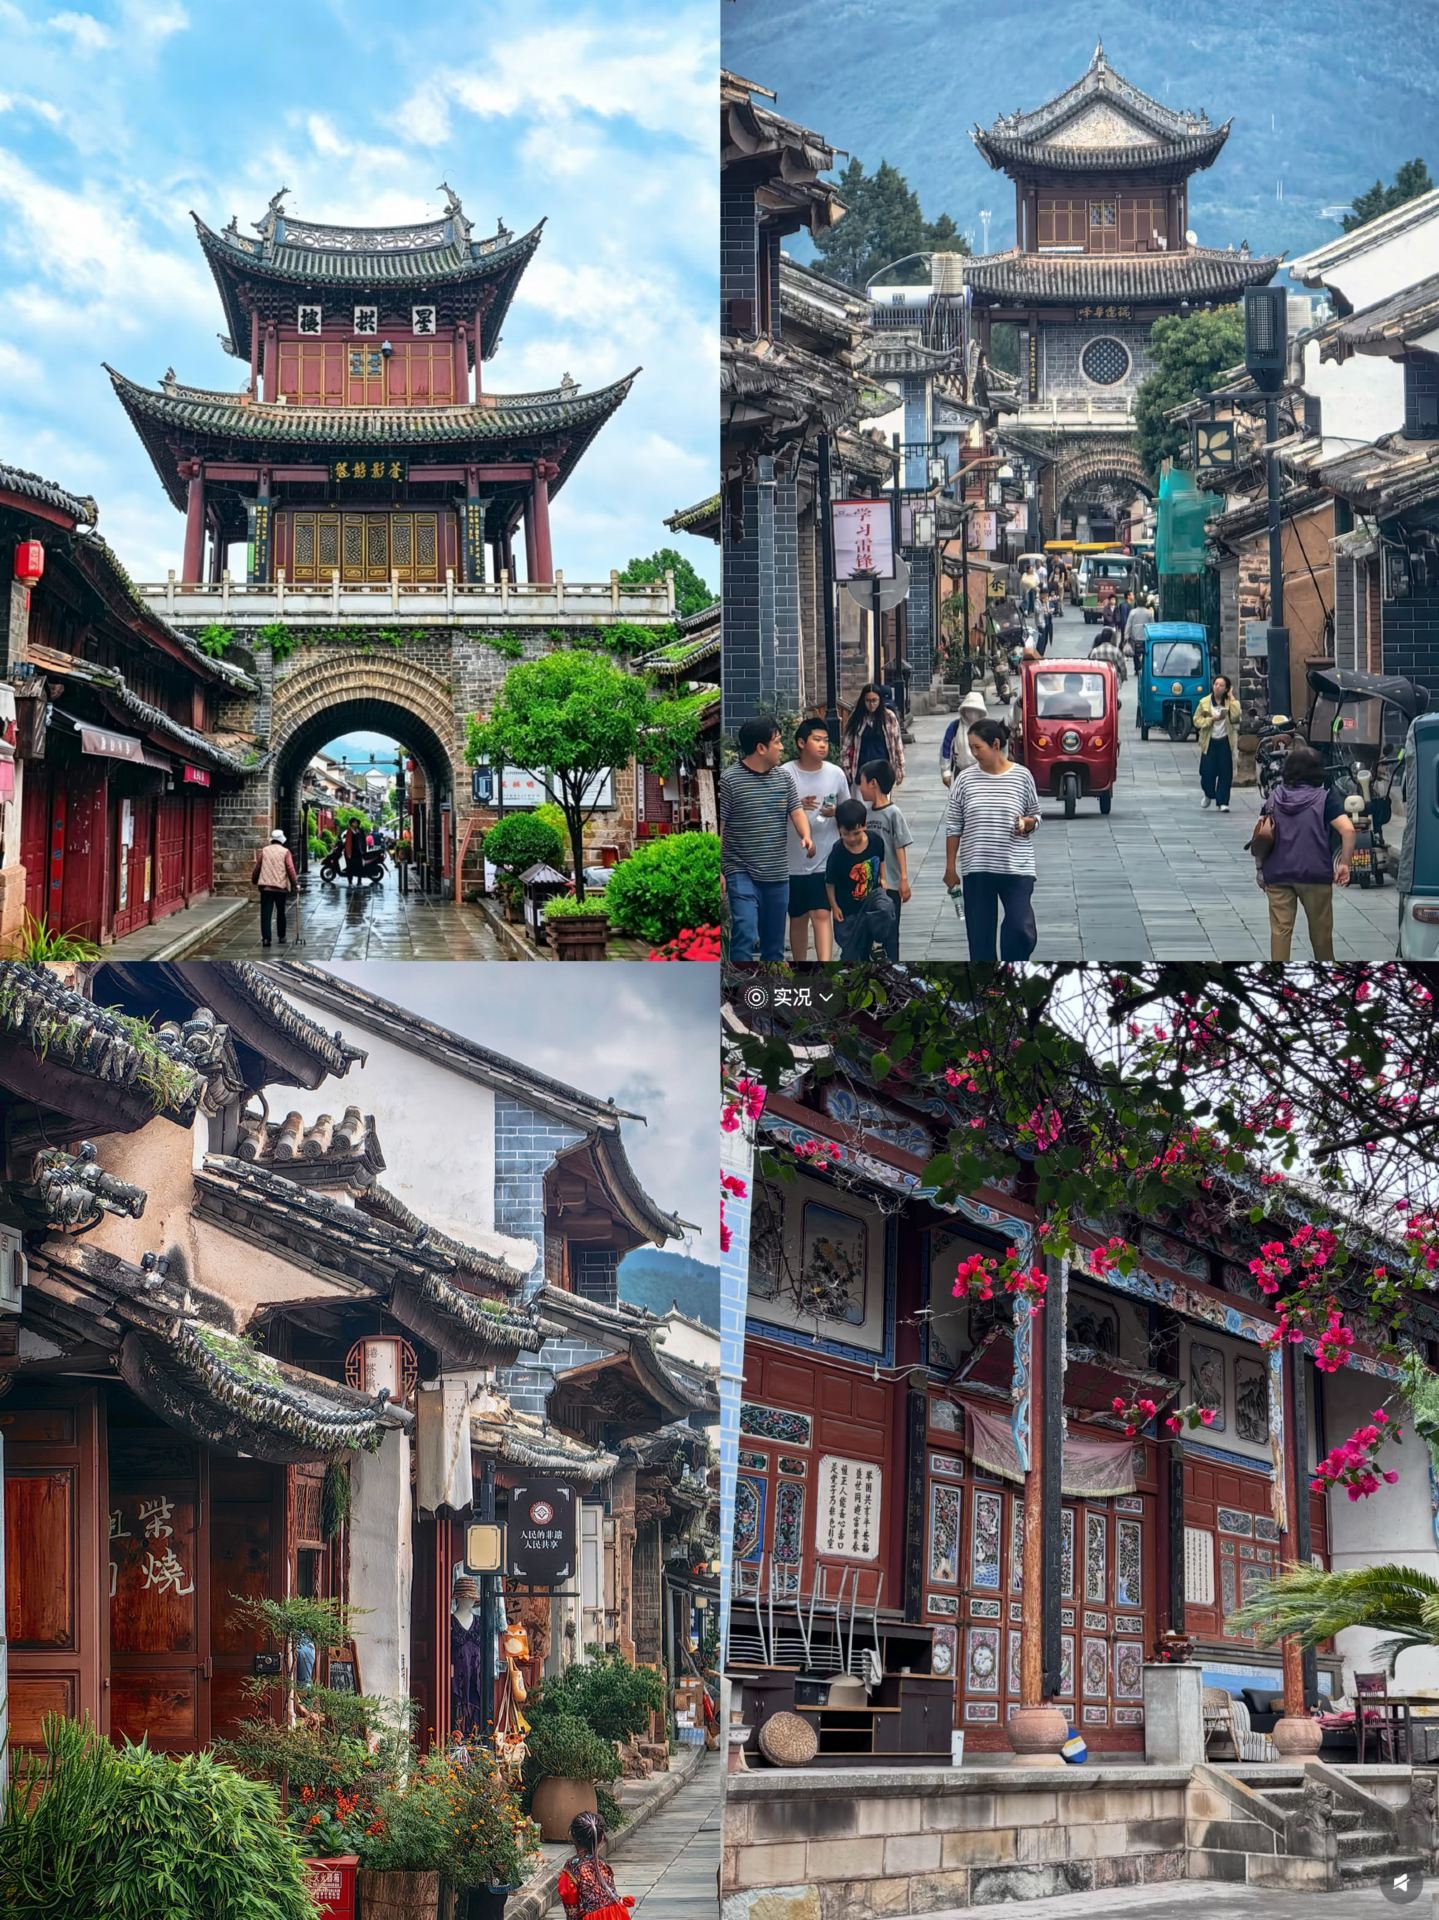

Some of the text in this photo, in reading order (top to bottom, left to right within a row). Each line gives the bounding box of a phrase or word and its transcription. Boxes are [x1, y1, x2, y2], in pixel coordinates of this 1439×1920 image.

[854, 507, 872, 568] 学习雷锋
[520, 1530, 563, 1540] 人民的非遗
[524, 1540, 559, 1549] 人民共享
